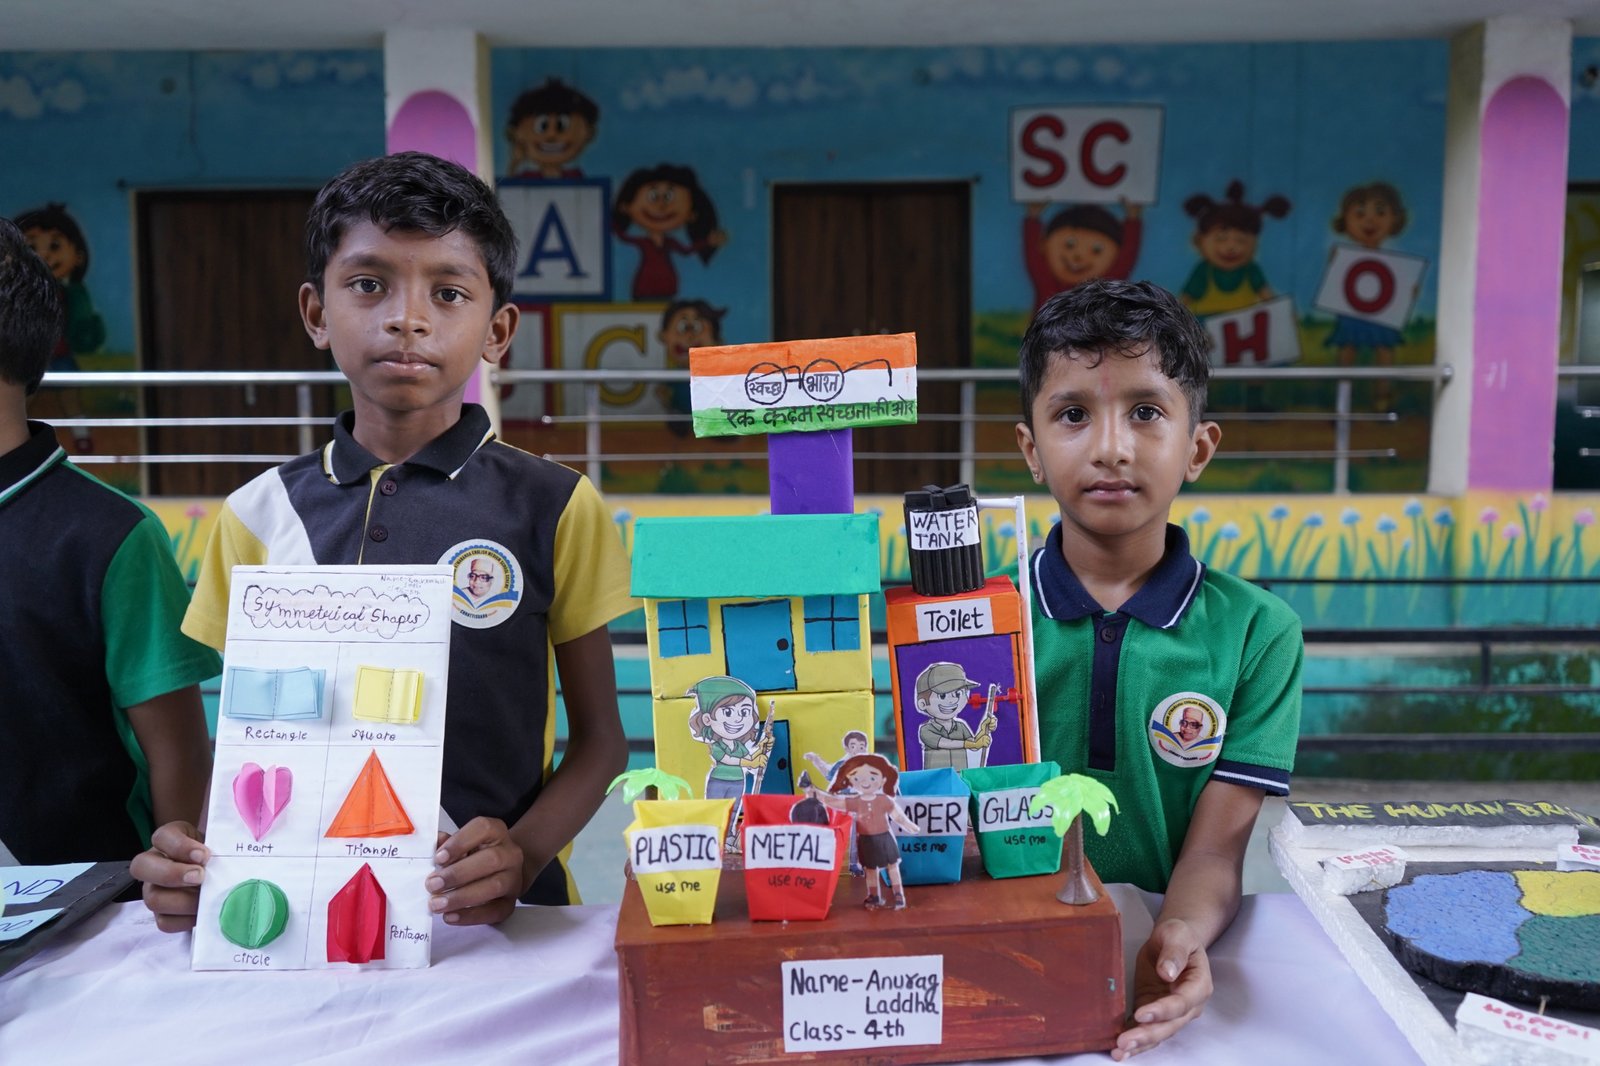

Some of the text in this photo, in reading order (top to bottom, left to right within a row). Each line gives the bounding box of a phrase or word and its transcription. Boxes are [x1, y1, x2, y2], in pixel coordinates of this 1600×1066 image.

[1020, 115, 1132, 188] SC
[518, 201, 590, 278] A
[1343, 258, 1396, 314] O
[1222, 310, 1270, 366] H
[584, 325, 647, 406] C
[806, 373, 840, 393] भारत
[721, 408, 755, 428] एक
[763, 405, 815, 427] कदम
[913, 509, 977, 532] WATER
[915, 531, 965, 549] TANK
[371, 607, 422, 625] Shapes
[924, 606, 984, 633] Toilet
[245, 726, 308, 742] Rectangle
[1292, 803, 1375, 819] THE
[1383, 800, 1504, 819] HUMAN
[236, 843, 274, 854] Heart
[635, 833, 717, 866] PLASTIC
[751, 832, 831, 864] METAL
[901, 842, 948, 853] use me
[1003, 834, 1047, 846] use me
[655, 880, 702, 894] use me
[768, 873, 816, 889] use me
[389, 924, 430, 944] Pentagon
[865, 992, 940, 1015] Laddha
[863, 1018, 905, 1041] 4th
